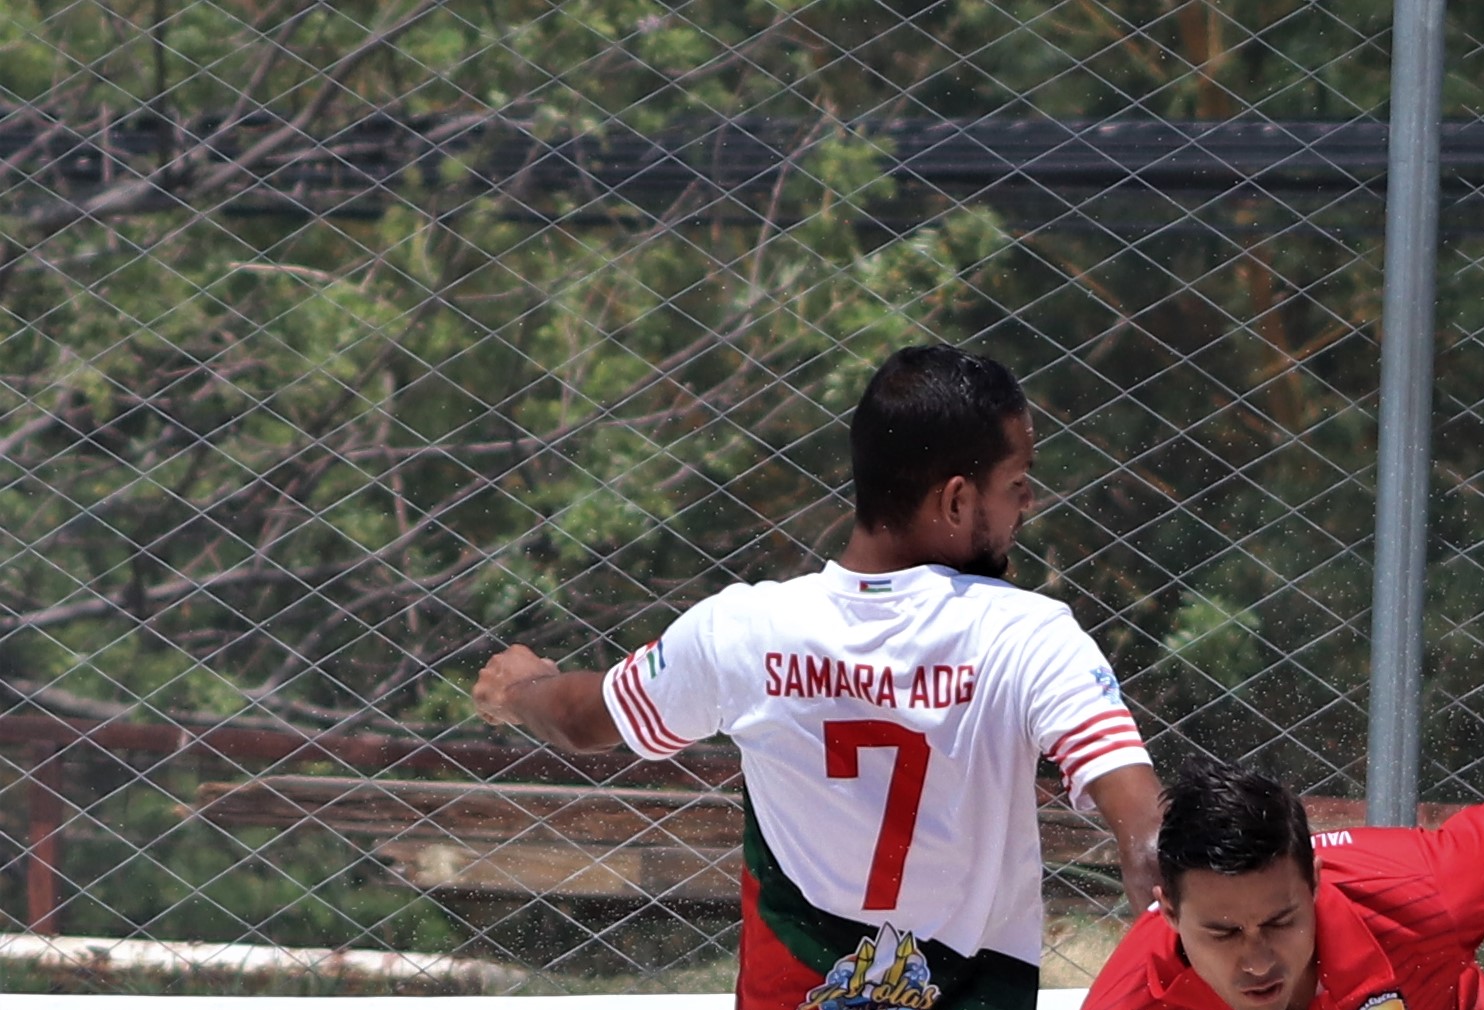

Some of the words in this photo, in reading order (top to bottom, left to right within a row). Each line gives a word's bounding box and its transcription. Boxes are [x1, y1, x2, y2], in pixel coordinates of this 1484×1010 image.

[765, 652, 897, 709] SAMARA
[909, 665, 975, 709] ADG
[824, 720, 929, 911] 7
